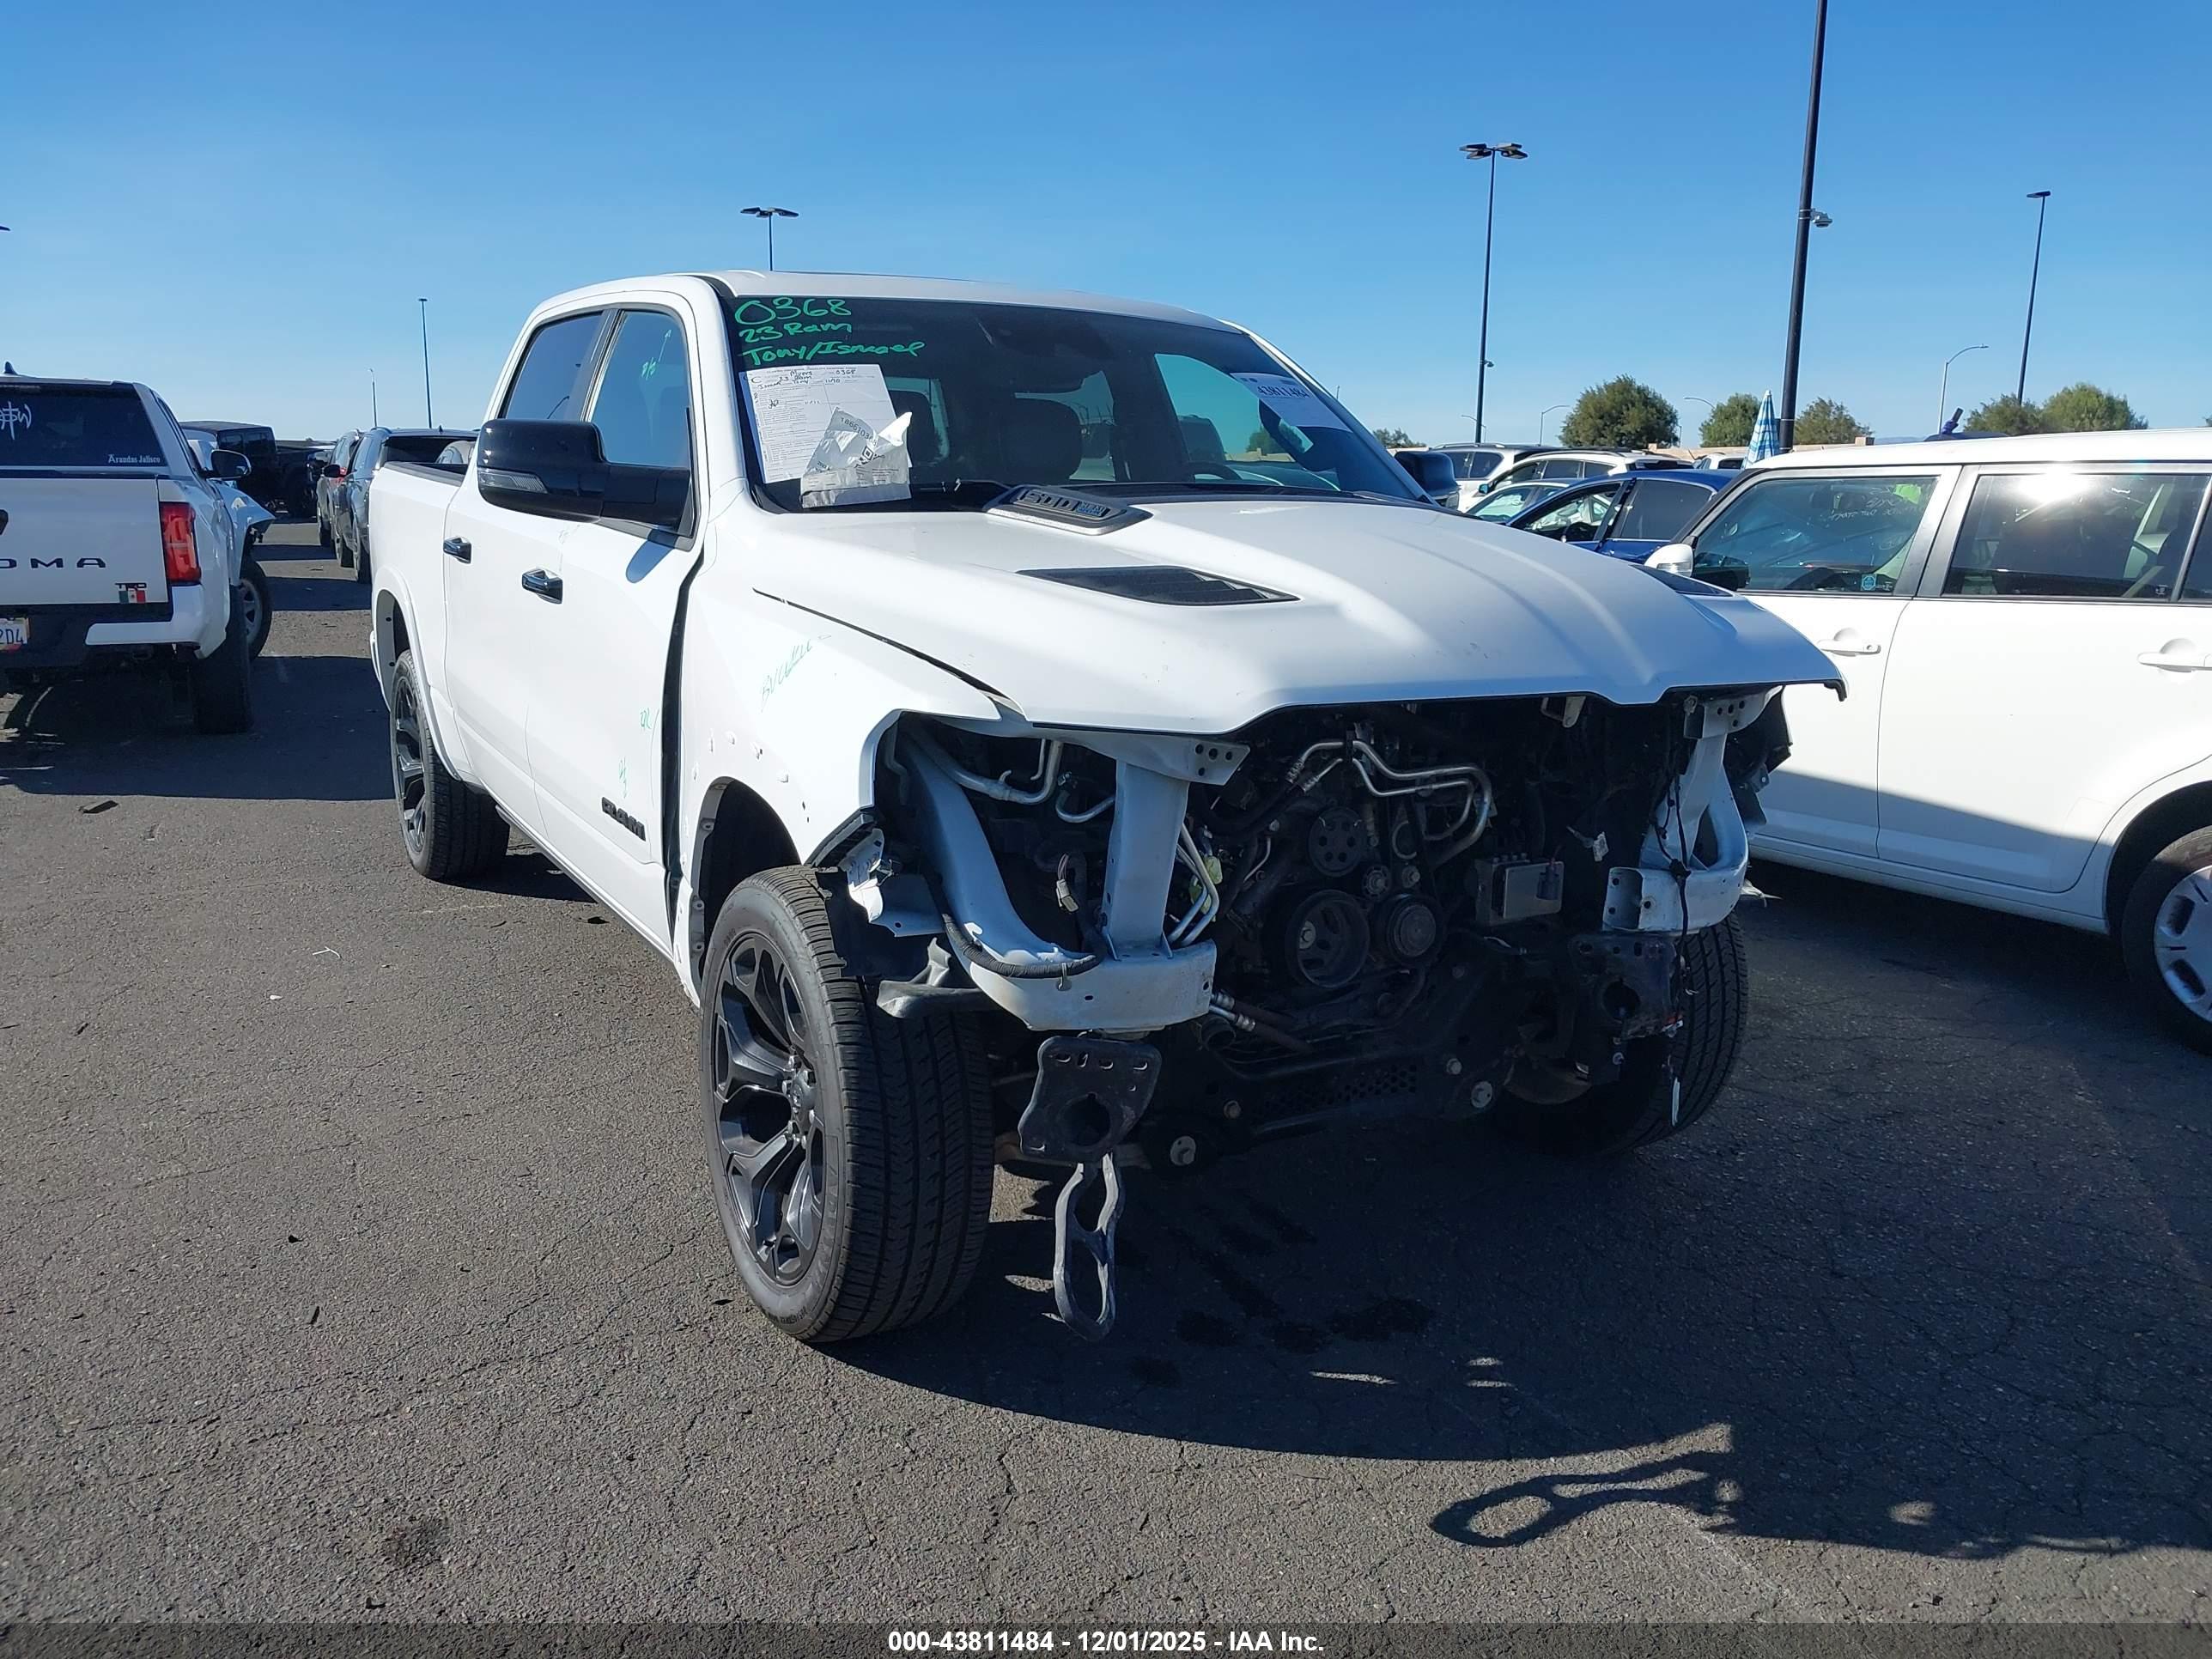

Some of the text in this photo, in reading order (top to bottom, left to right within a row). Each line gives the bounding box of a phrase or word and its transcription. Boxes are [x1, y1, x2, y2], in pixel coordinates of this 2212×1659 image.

[734, 295, 852, 325] 0368
[739, 322, 853, 343] 23 Ram
[601, 796, 647, 842] RAM
